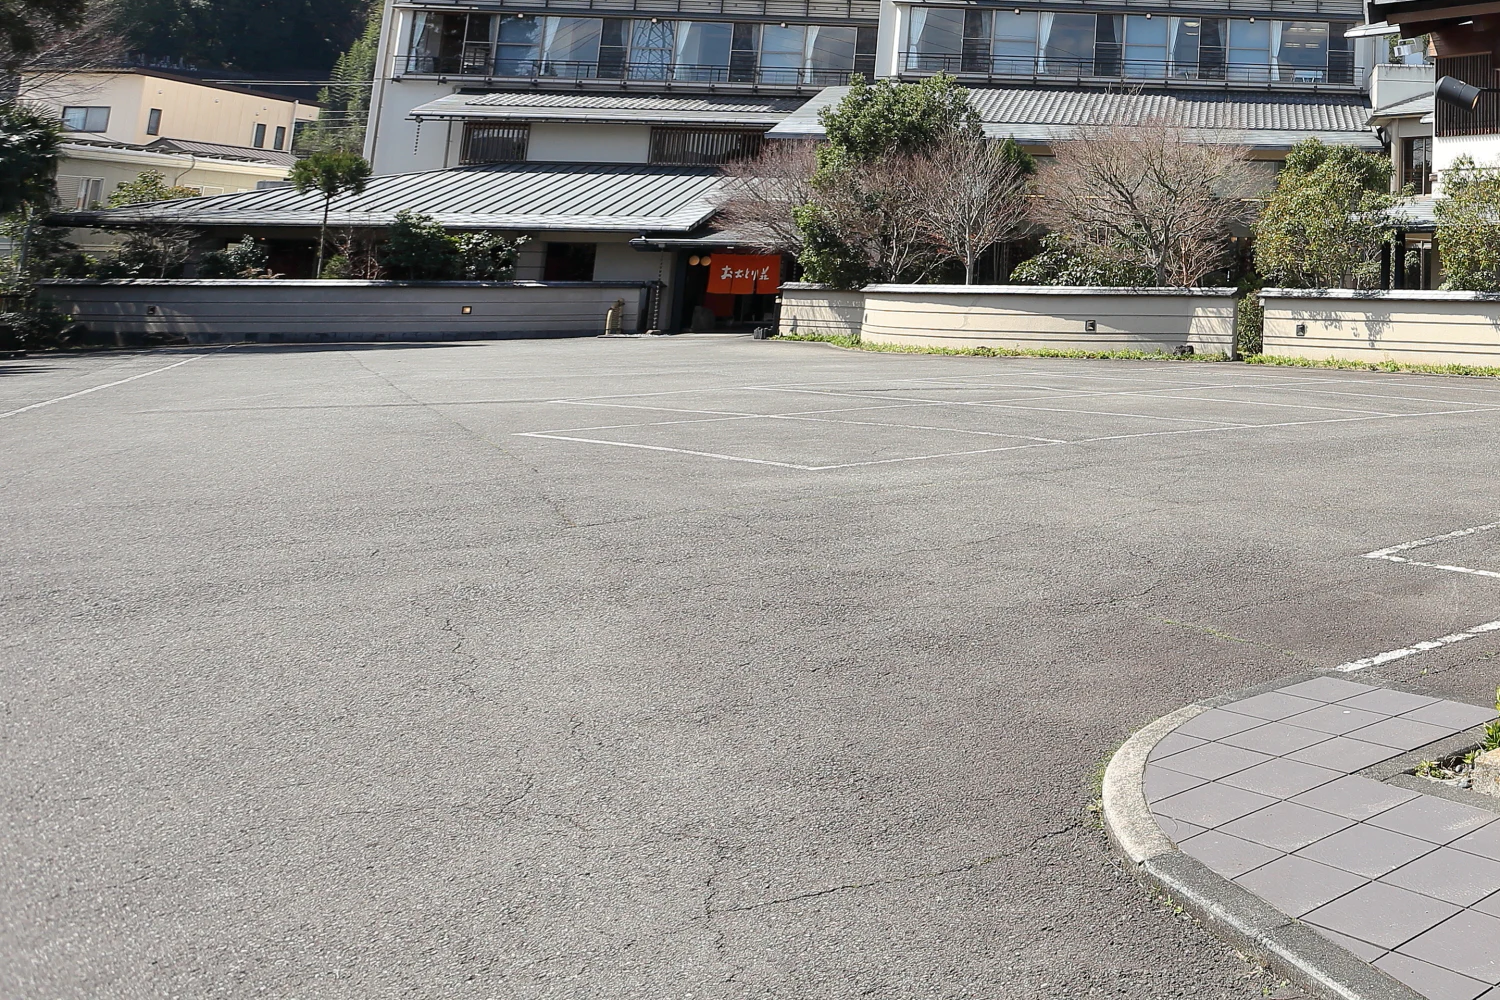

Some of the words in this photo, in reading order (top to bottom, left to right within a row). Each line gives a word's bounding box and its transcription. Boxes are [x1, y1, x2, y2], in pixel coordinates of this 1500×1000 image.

[720, 265, 770, 281] おおとり荘
